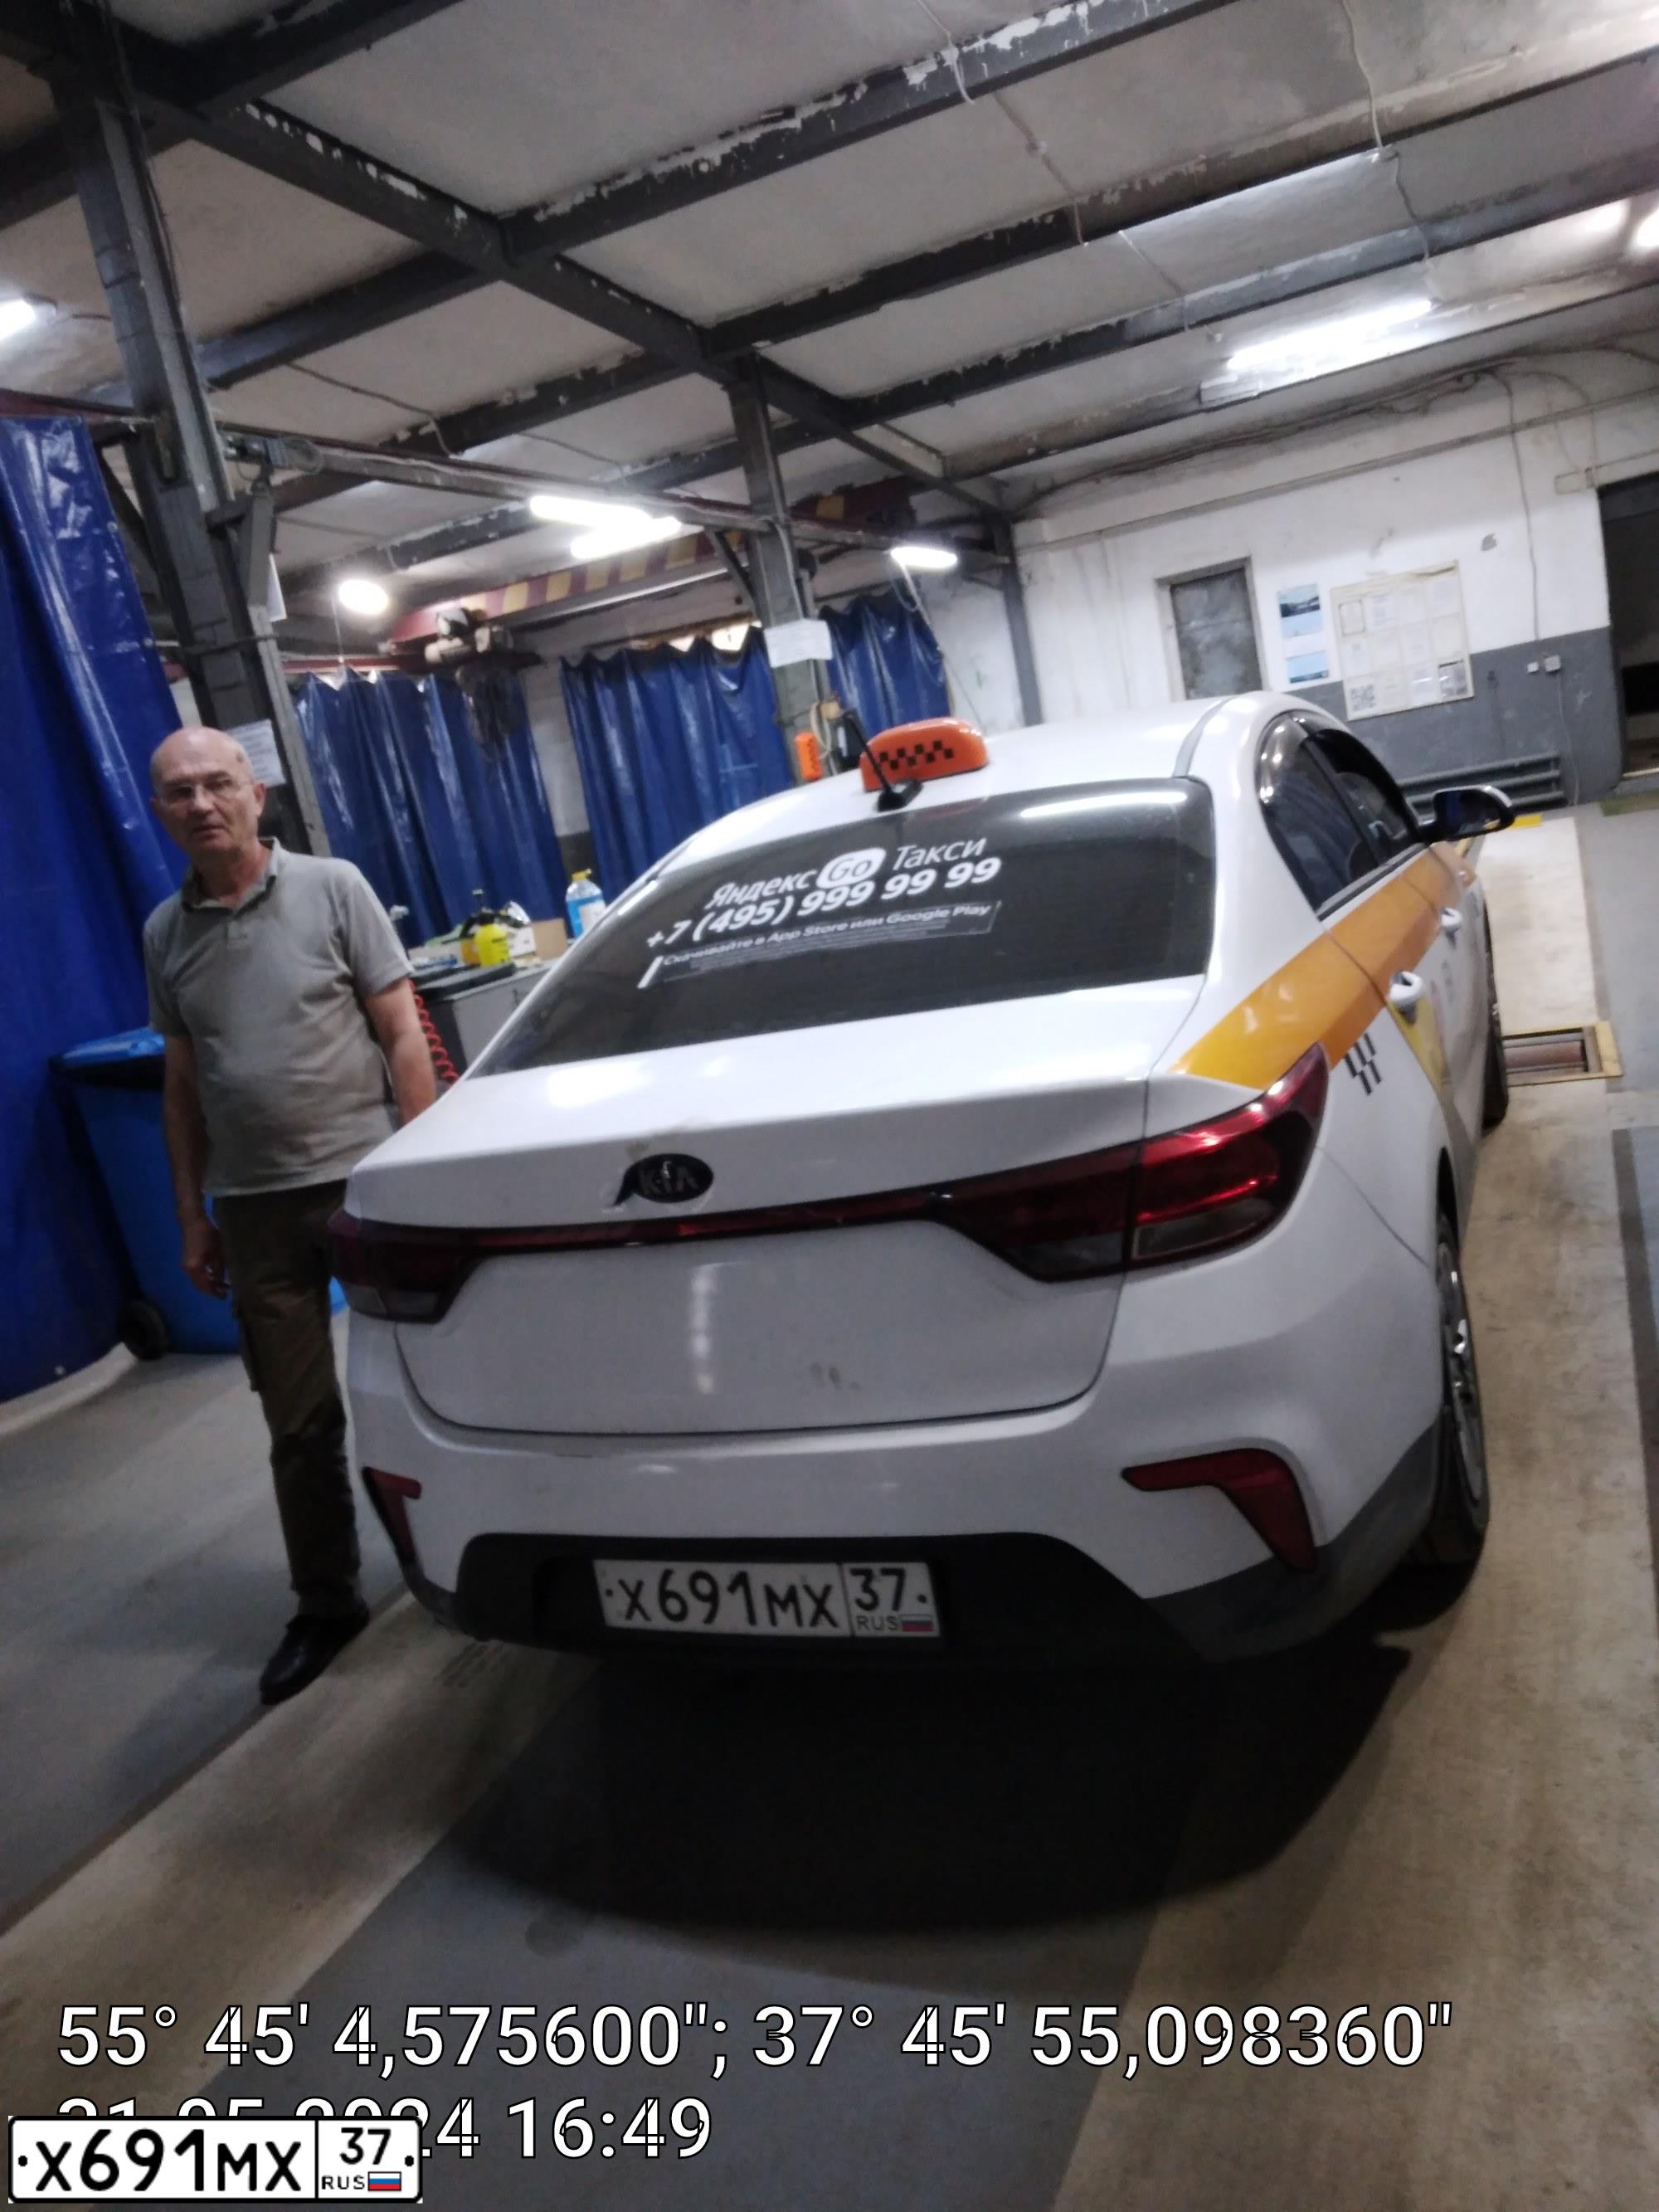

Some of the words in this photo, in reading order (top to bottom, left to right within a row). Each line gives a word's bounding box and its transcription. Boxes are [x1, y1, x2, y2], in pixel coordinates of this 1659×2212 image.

[705, 870, 818, 909] Яндекс
[893, 838, 988, 871] Такси
[647, 919, 692, 948] +7
[692, 896, 795, 941] (495)
[796, 881, 876, 916] 999
[881, 869, 937, 899] 99
[944, 857, 1002, 889] 99
[766, 930, 801, 944] App
[802, 922, 848, 937] Store
[850, 918, 884, 928] или
[886, 909, 950, 924] Google
[952, 905, 991, 917] Play
[849, 1566, 907, 1612] 37
[855, 1615, 900, 1632] RUS
